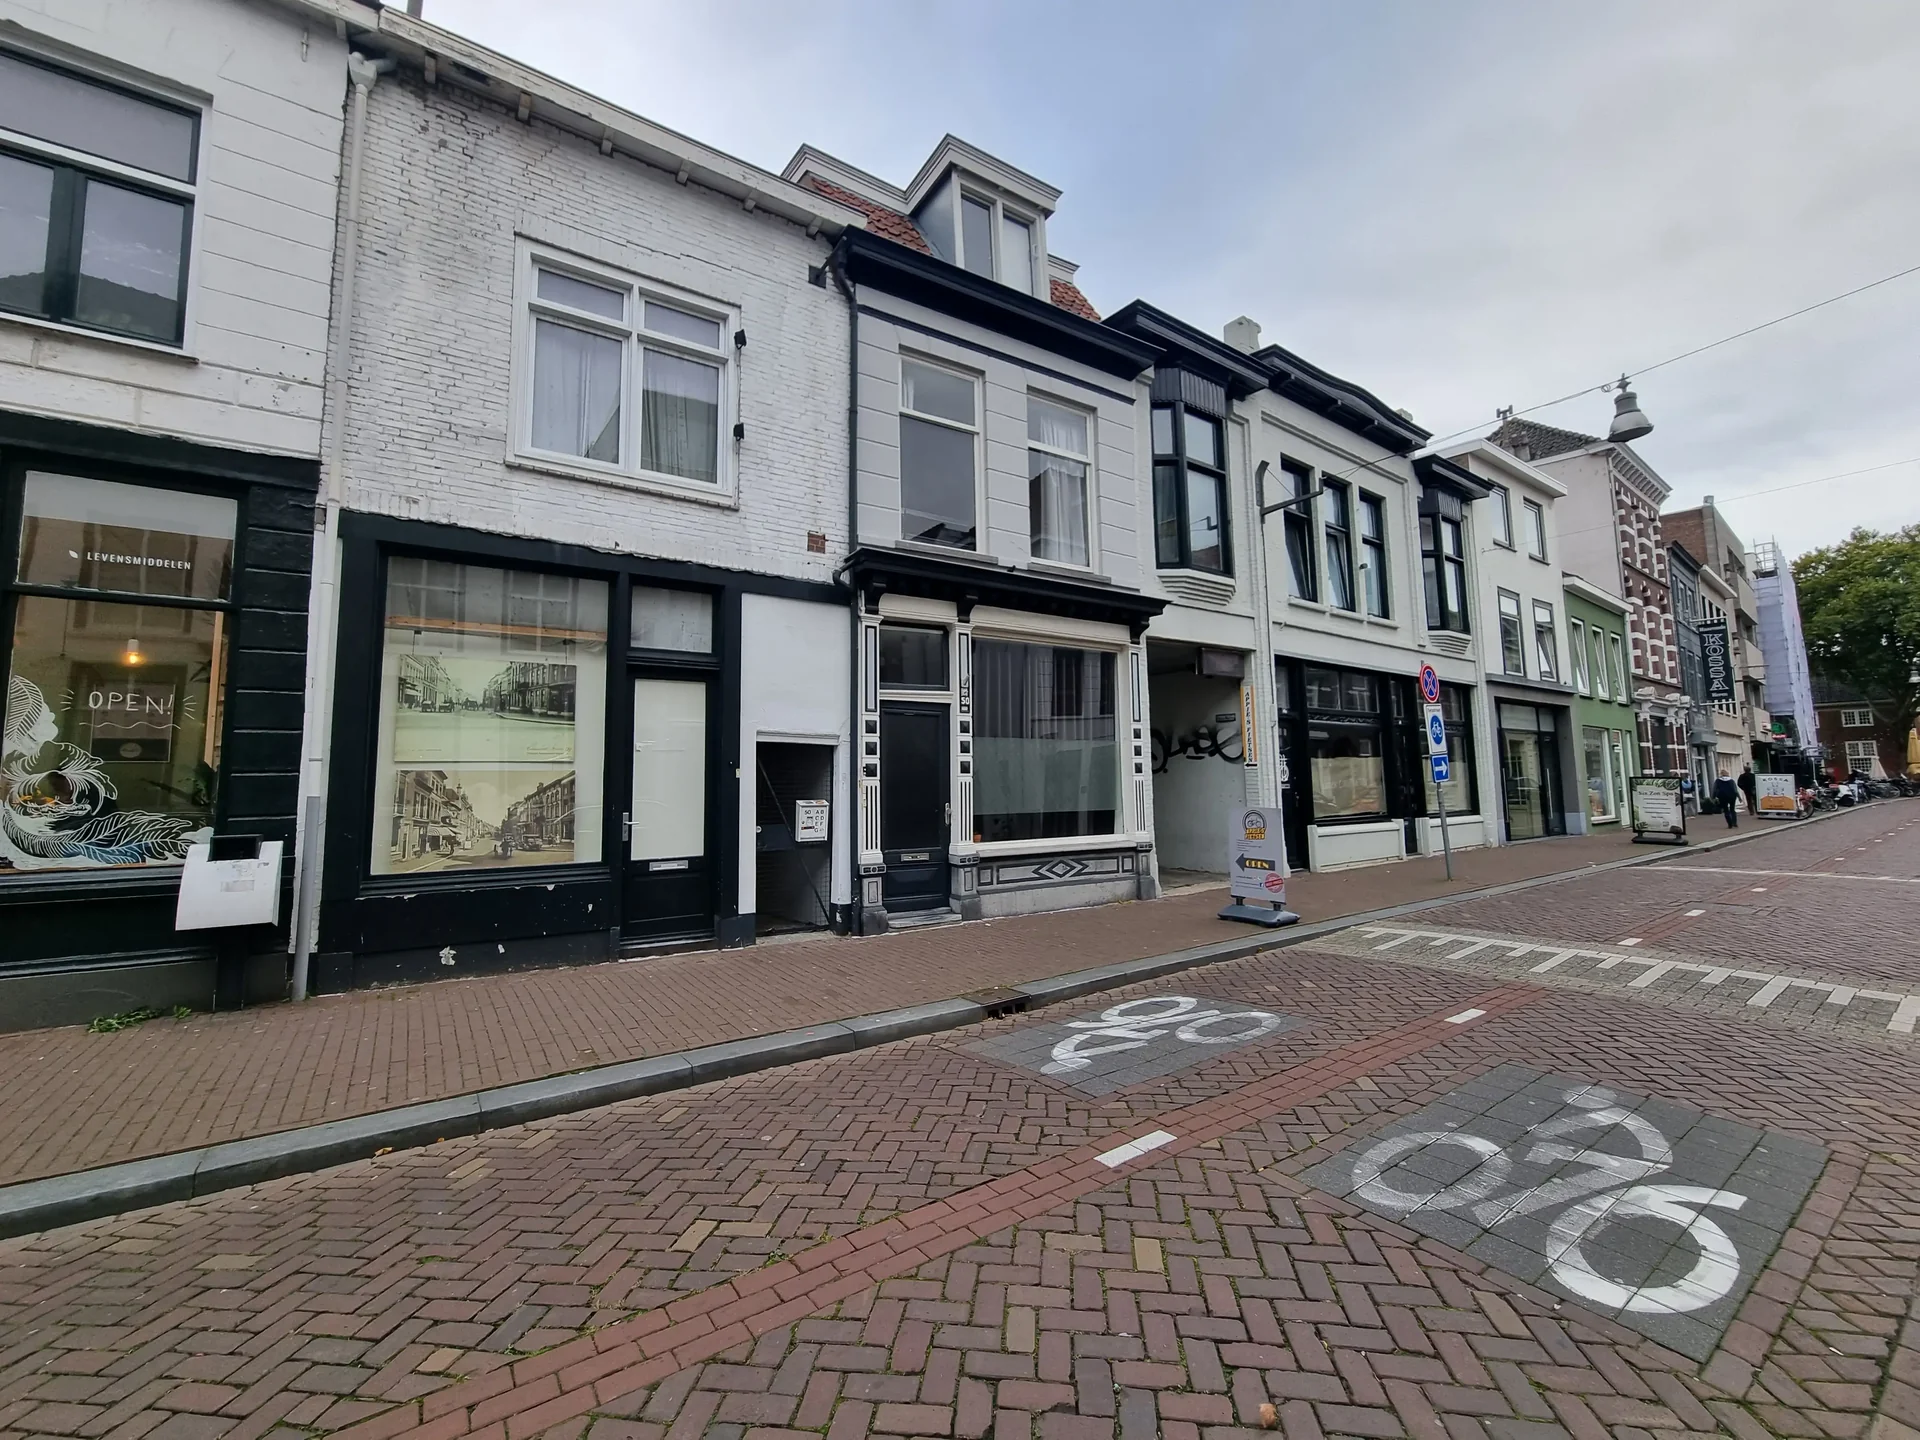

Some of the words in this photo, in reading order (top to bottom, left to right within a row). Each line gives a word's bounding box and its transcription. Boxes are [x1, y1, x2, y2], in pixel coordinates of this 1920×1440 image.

[87, 552, 191, 570] LEVENSMIDDELEN
[1703, 633, 1729, 691] KOSSA
[88, 691, 173, 715] OPEN!
[961, 697, 970, 705] 50
[1245, 860, 1270, 869] OPEN
